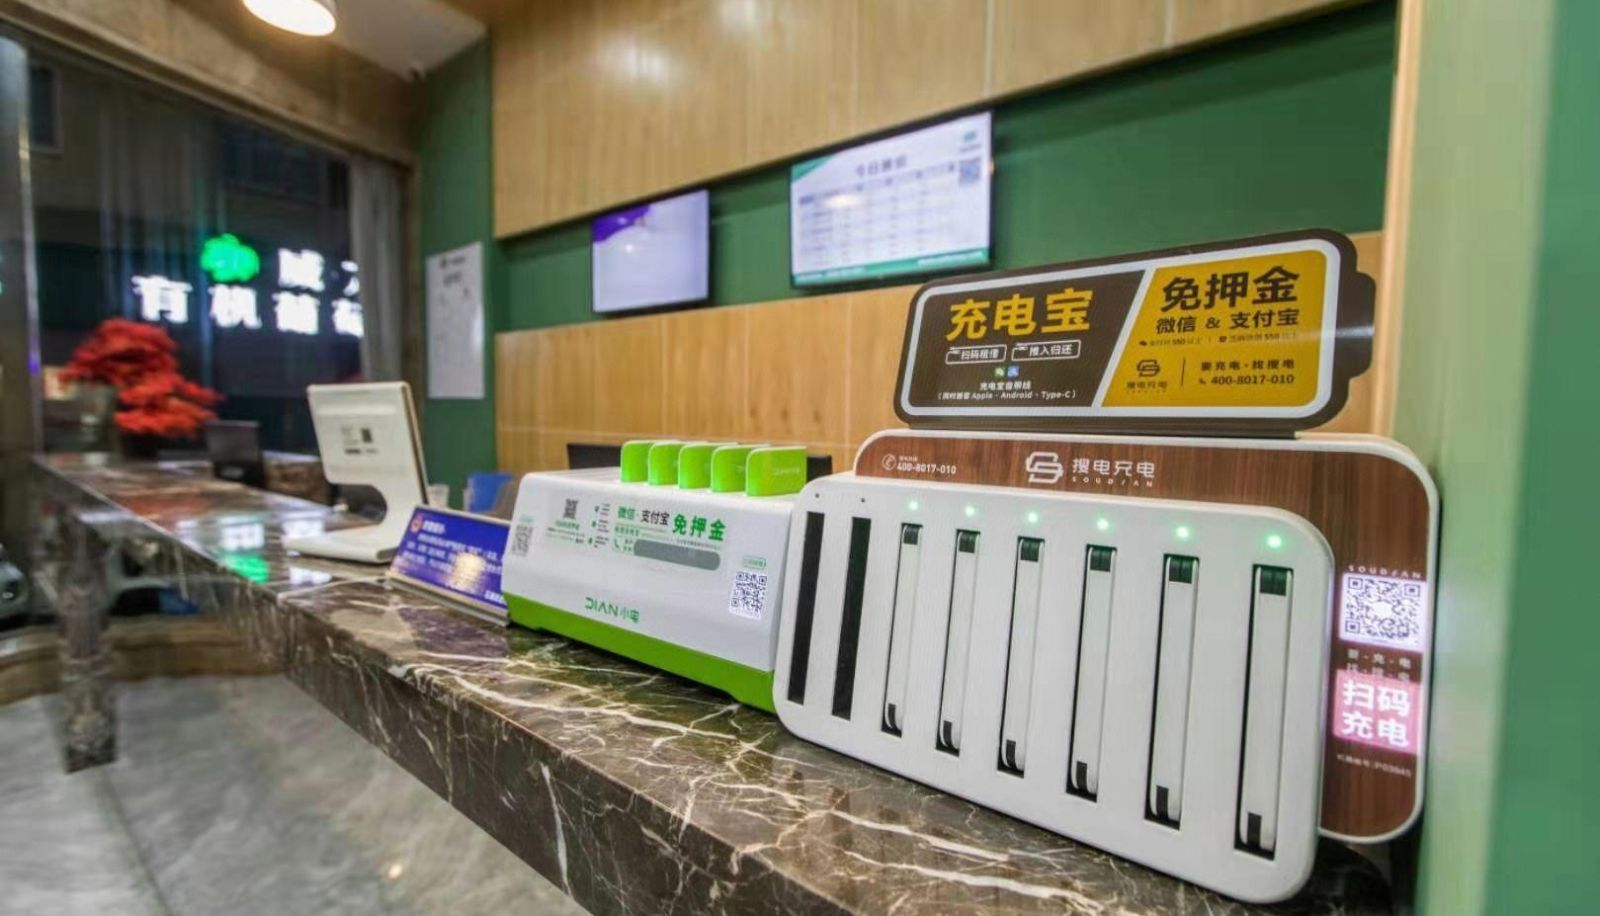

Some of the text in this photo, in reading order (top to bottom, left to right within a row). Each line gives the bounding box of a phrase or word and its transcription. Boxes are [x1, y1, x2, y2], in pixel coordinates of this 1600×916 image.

[1160, 265, 1300, 312] 免押金
[946, 287, 1093, 341] 充电宝
[1156, 308, 1299, 334] 微信 & 支付宝
[1211, 374, 1295, 385] 400-8017-010
[897, 462, 957, 475] 400-8017-010
[1072, 458, 1155, 478] 搜电充电
[672, 513, 725, 541] 免押金
[1342, 679, 1411, 717] 扫码
[1342, 711, 1410, 748] 充电
